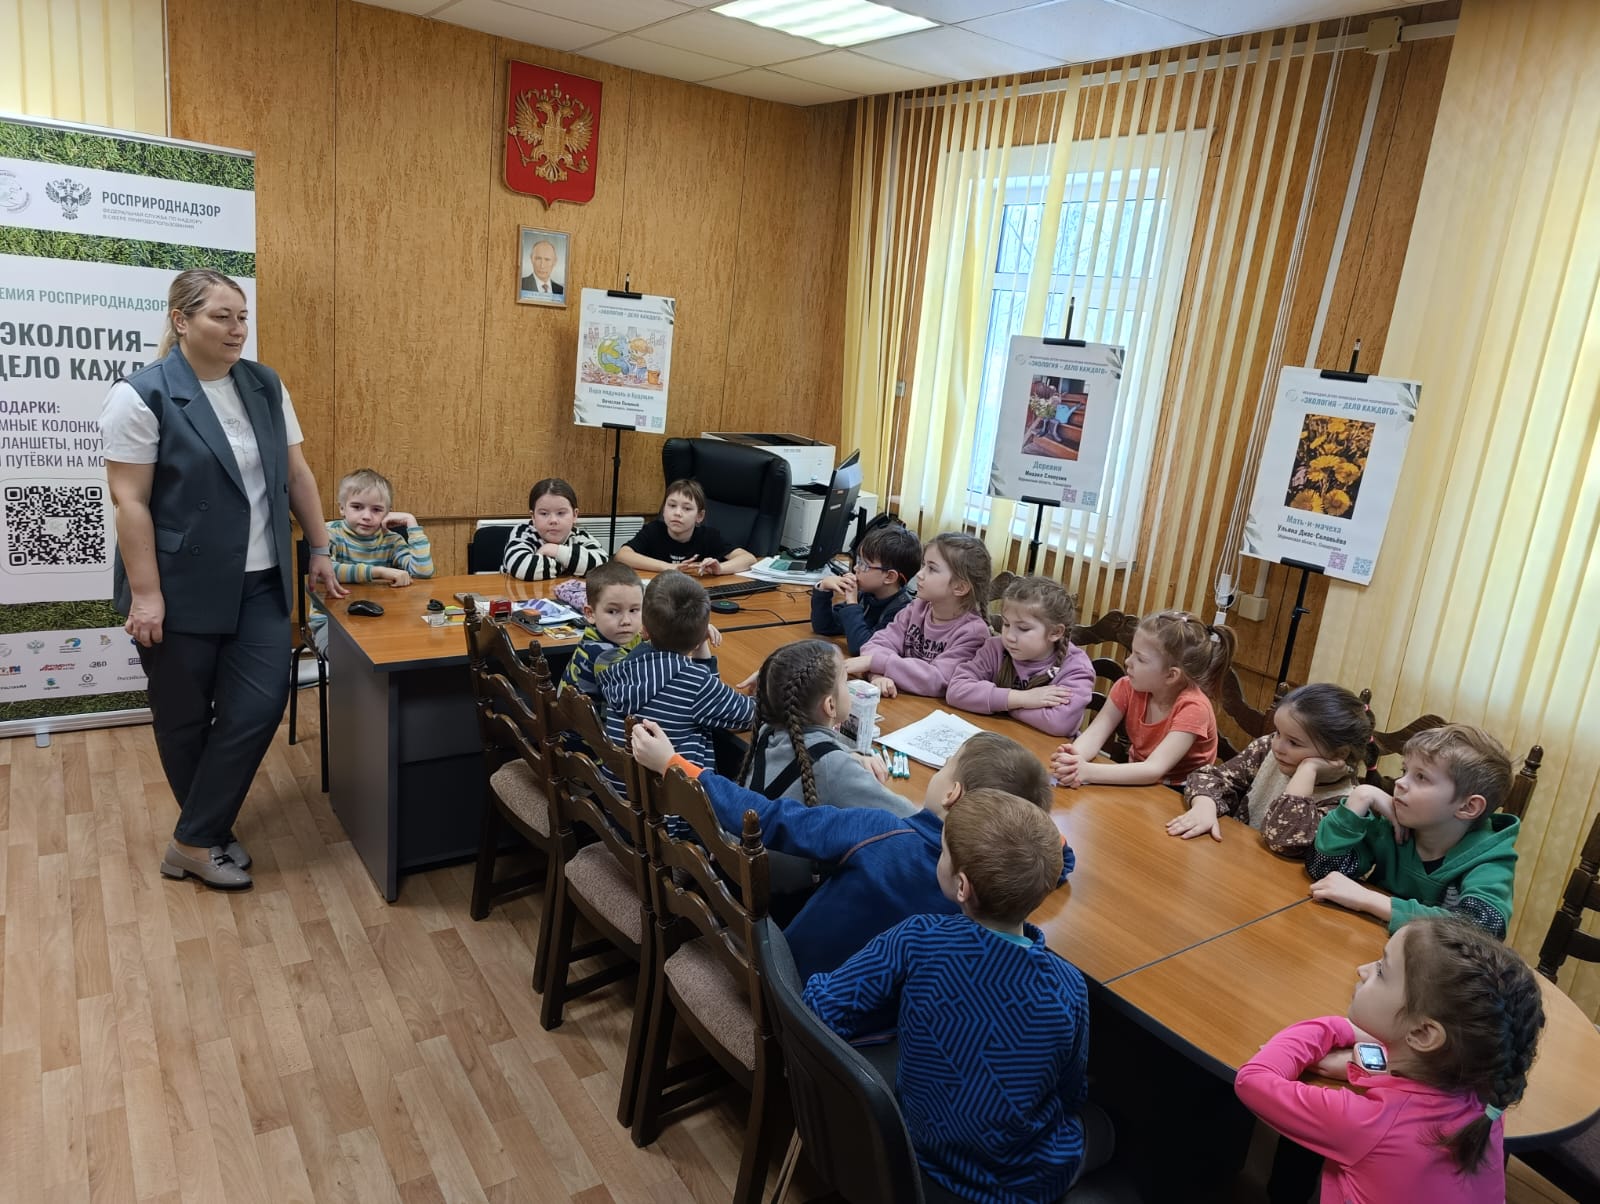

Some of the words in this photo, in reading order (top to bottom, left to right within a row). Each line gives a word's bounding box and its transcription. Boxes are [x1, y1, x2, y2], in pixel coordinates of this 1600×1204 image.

[102, 191, 221, 217] РОСПРИРОДНАДЗОР
[6, 451, 63, 469] ПУТЁВКИ
[67, 455, 84, 468] НА
